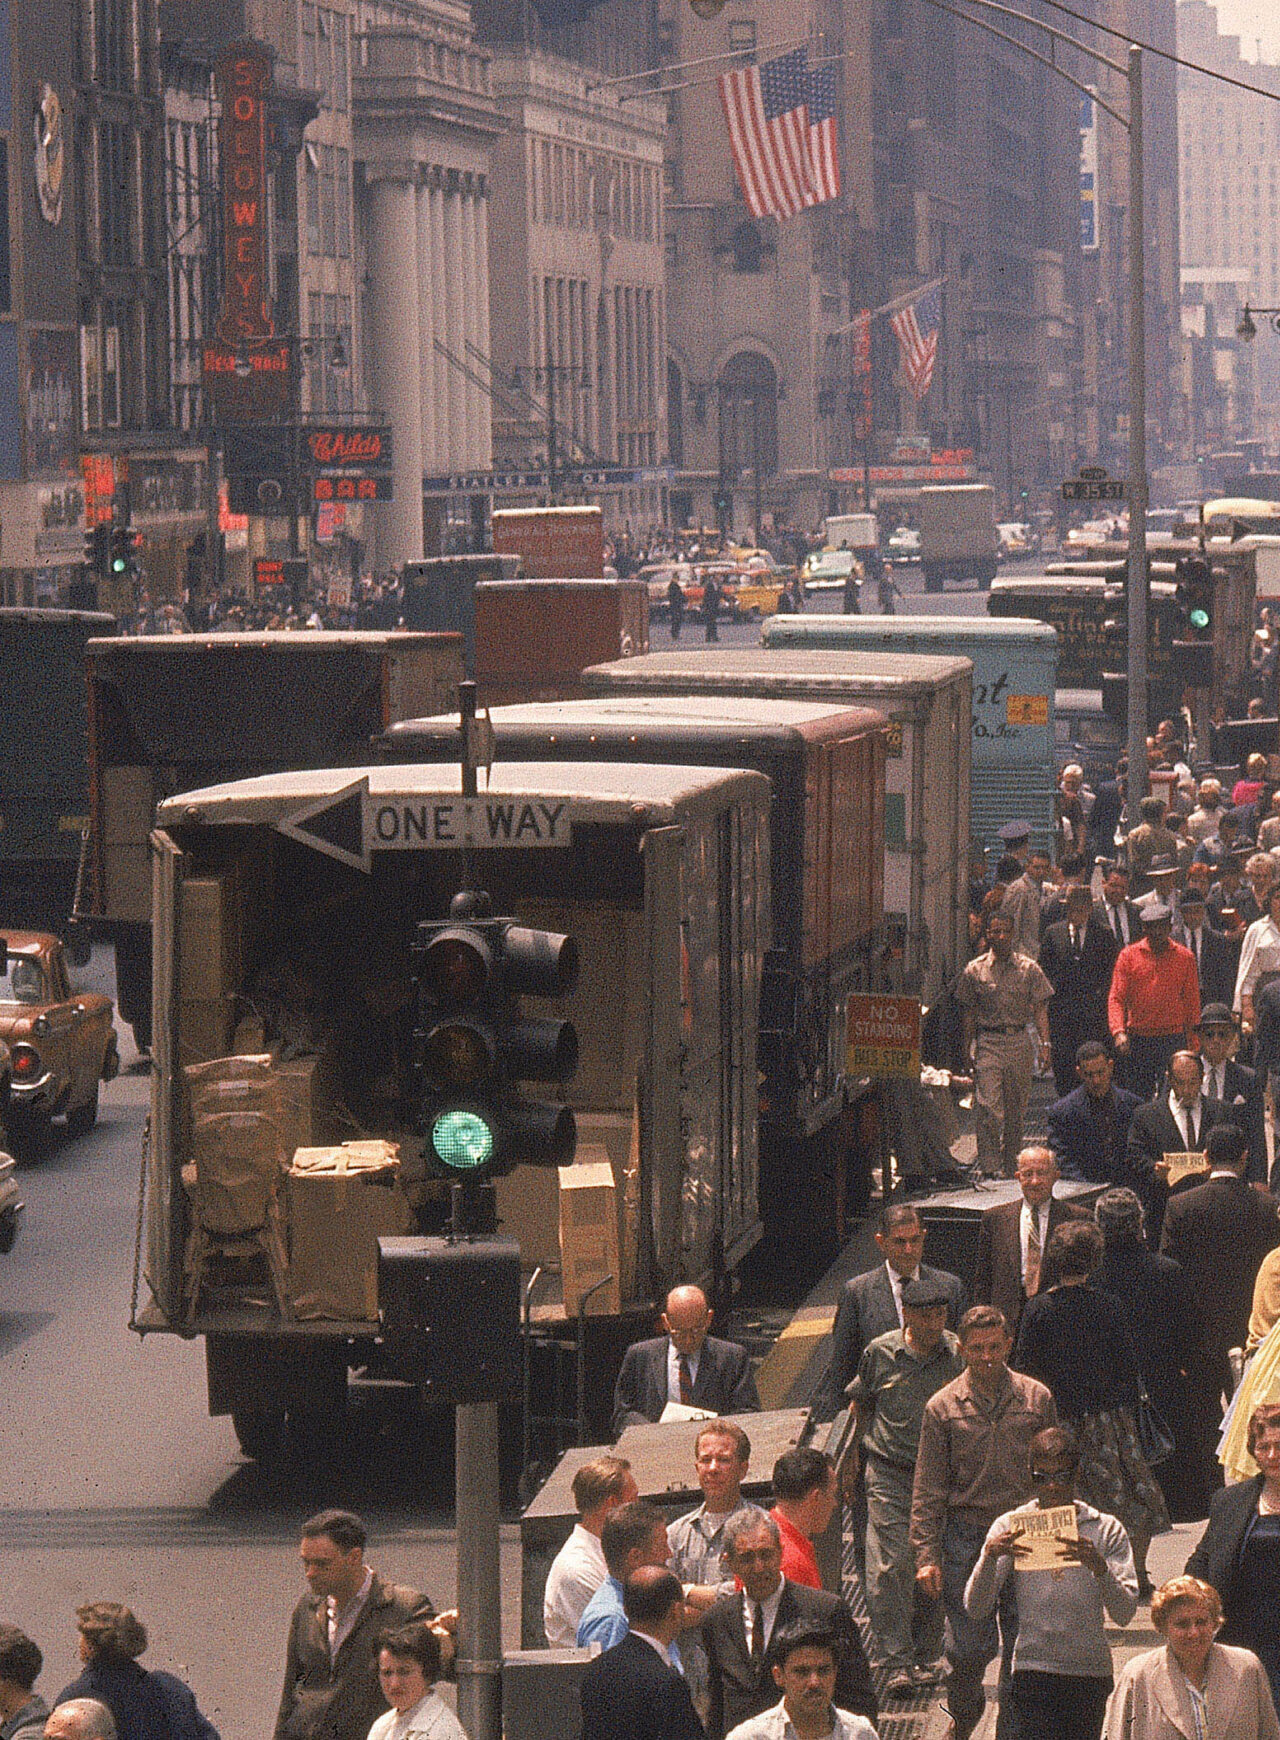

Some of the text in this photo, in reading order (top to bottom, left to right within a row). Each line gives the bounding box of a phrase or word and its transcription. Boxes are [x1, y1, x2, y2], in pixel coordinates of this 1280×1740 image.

[314, 479, 377, 499] BAR
[375, 802, 566, 841] ONE WAY
[870, 1005, 899, 1021] NO
[855, 1021, 912, 1039] STANDING
[855, 1048, 912, 1067] BUS STOP
